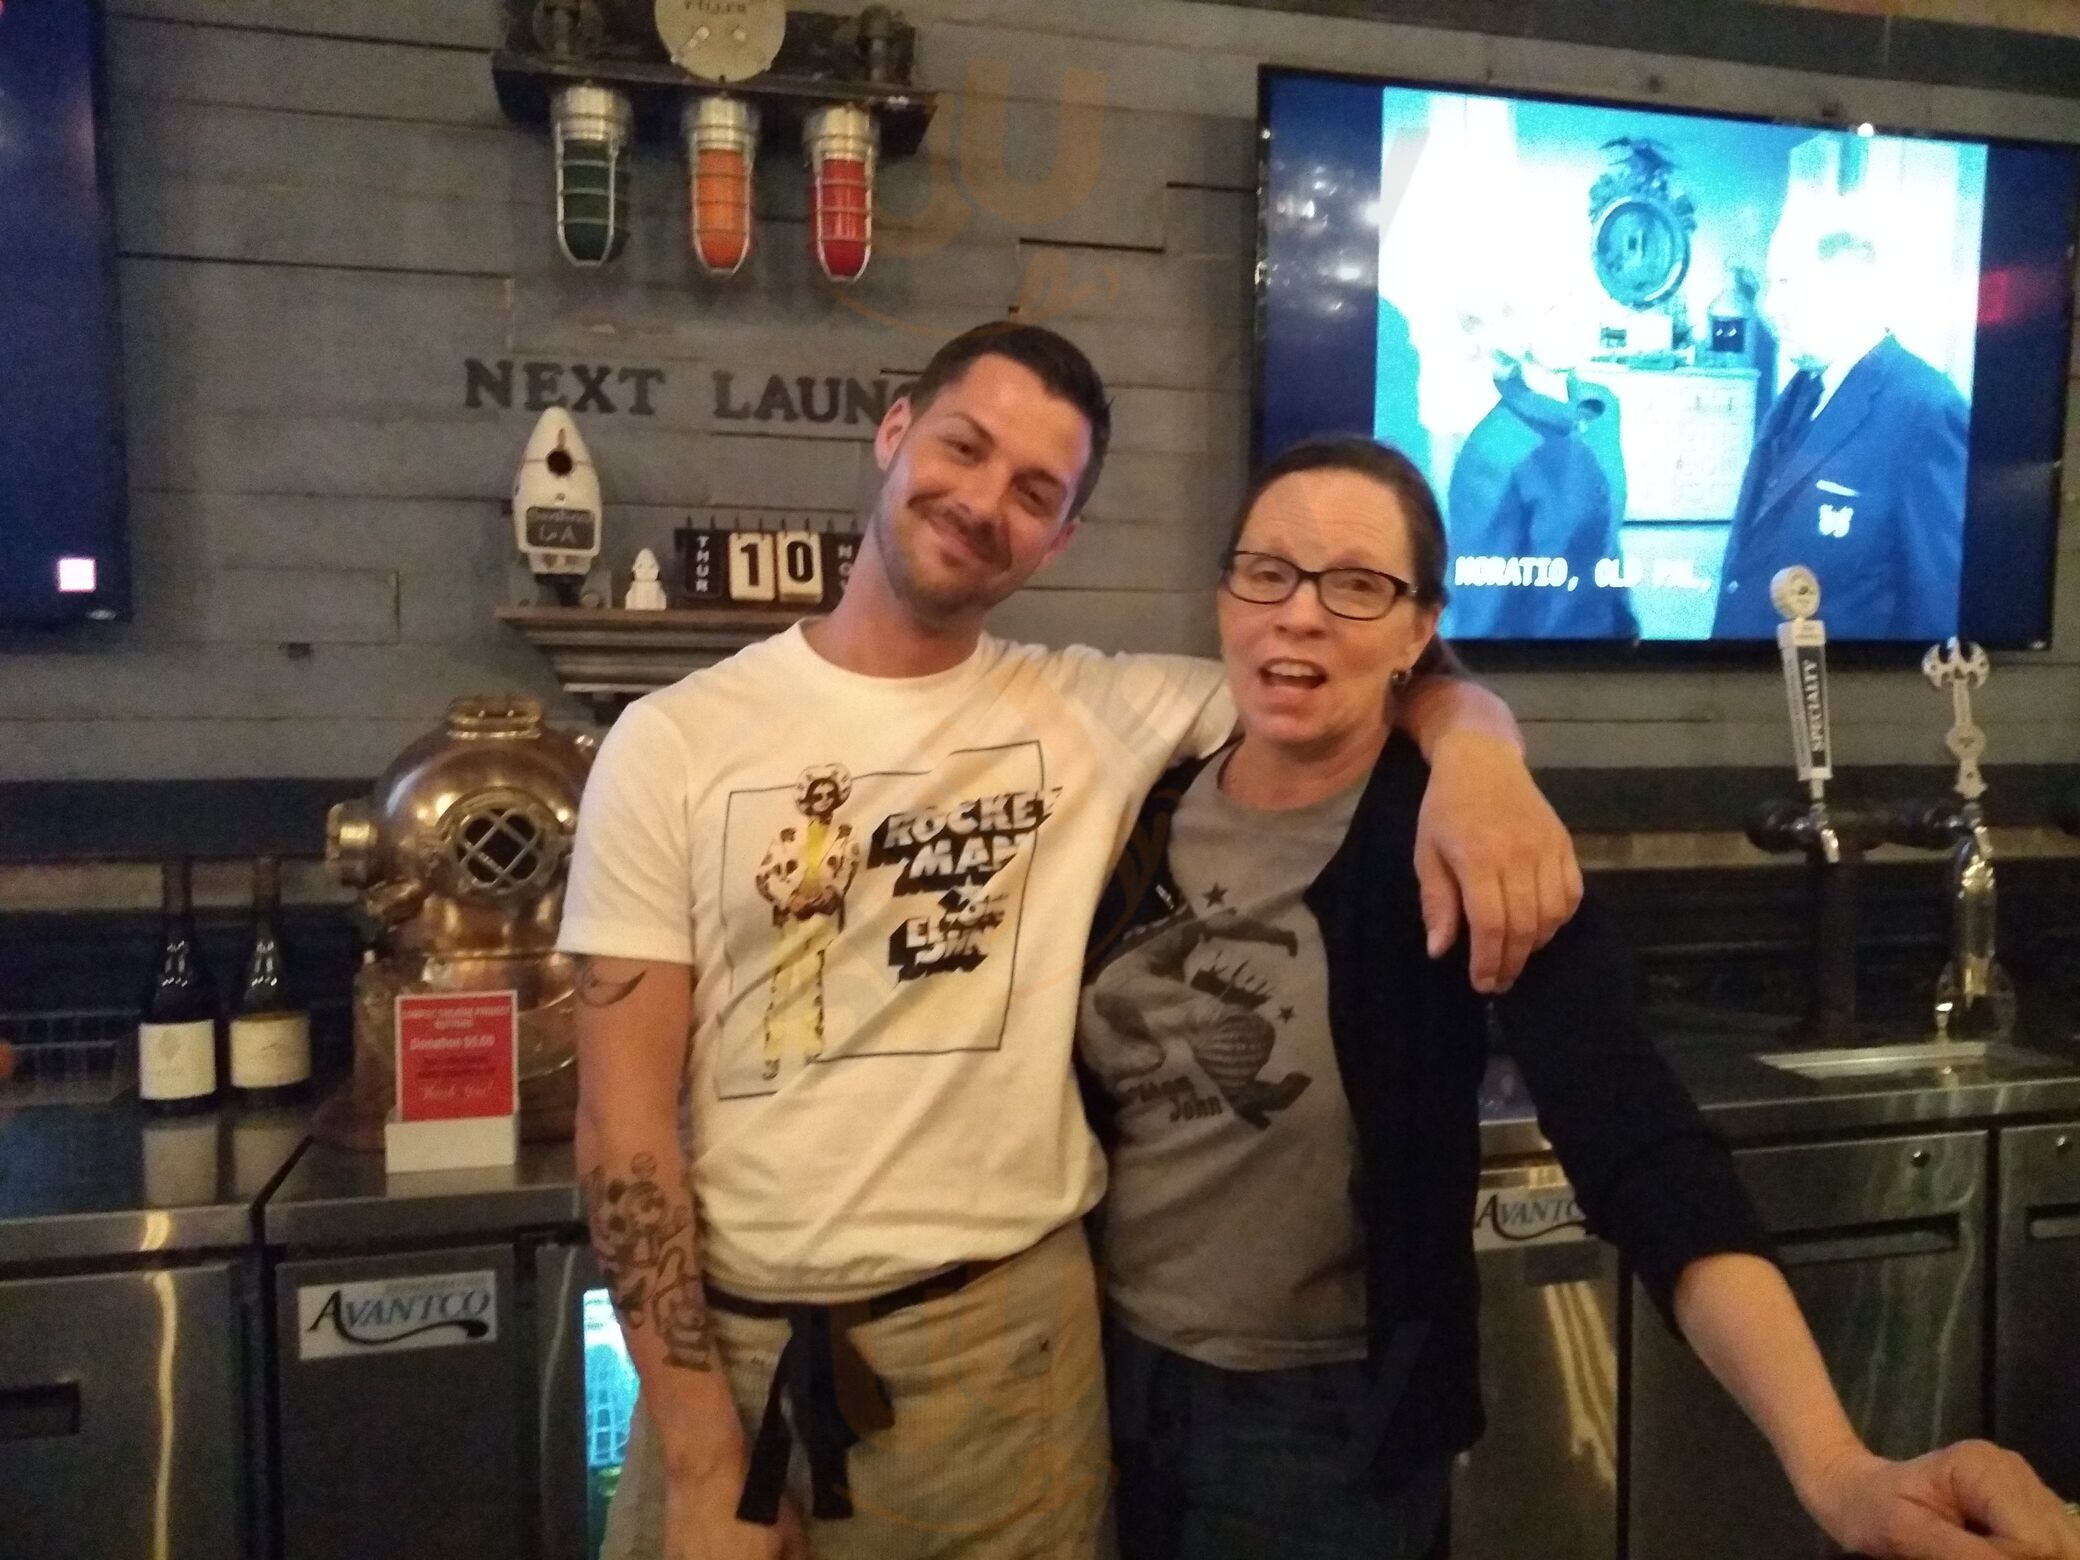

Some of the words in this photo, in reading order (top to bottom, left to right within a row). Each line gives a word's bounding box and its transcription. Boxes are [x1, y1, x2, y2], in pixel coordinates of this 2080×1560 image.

[464, 358, 666, 417] NEXT
[711, 369, 919, 425] LAUN
[740, 540, 814, 587] 10
[1454, 556, 1579, 592] HORATIO,
[867, 786, 1064, 864] ROCKE
[1474, 1193, 1586, 1238] AVANTC
